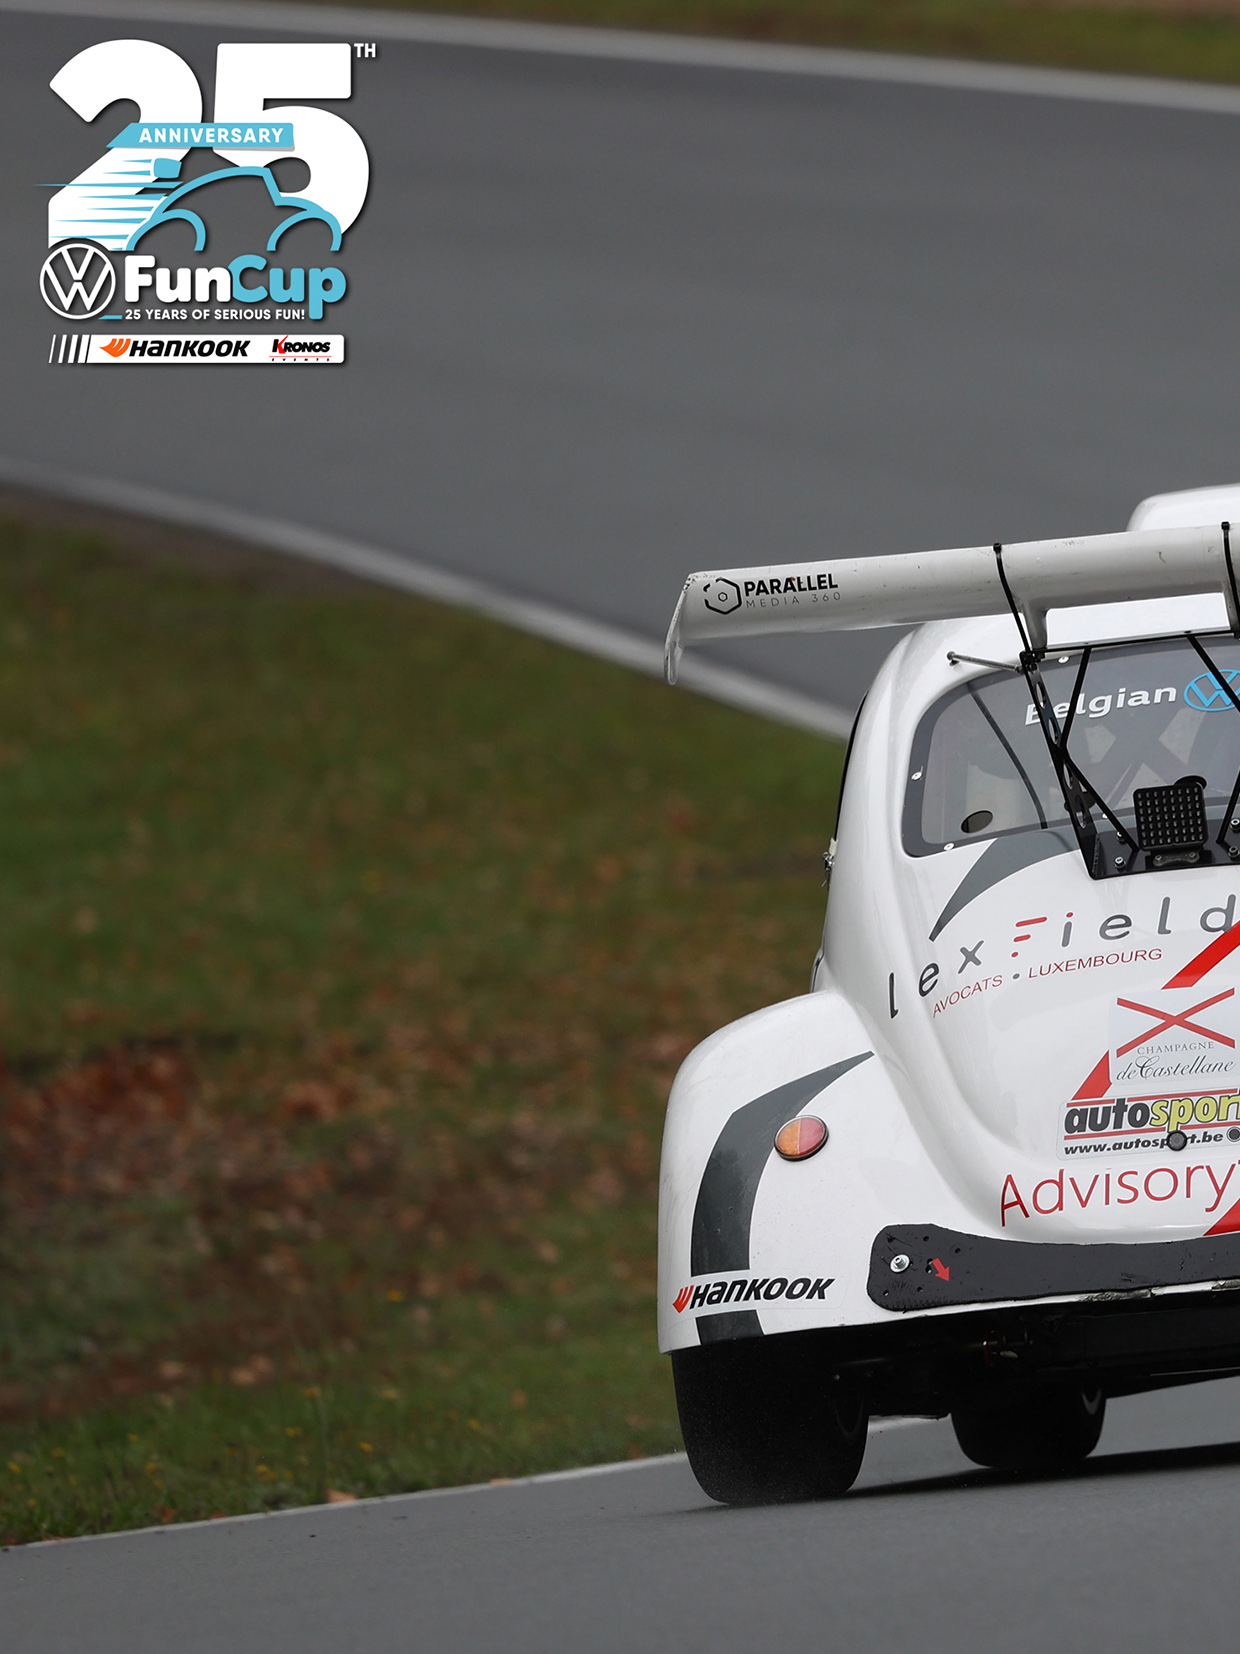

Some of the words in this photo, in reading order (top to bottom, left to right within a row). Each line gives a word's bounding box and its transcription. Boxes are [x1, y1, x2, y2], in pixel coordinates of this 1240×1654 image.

[743, 573, 839, 597] PARALLEL
[746, 595, 800, 609] MEDIA
[811, 591, 841, 603] 360
[932, 974, 1004, 1019] AVOCATS
[1028, 948, 1163, 979] LUXEMBOURG
[1137, 1041, 1215, 1055] CHAMPAGNE
